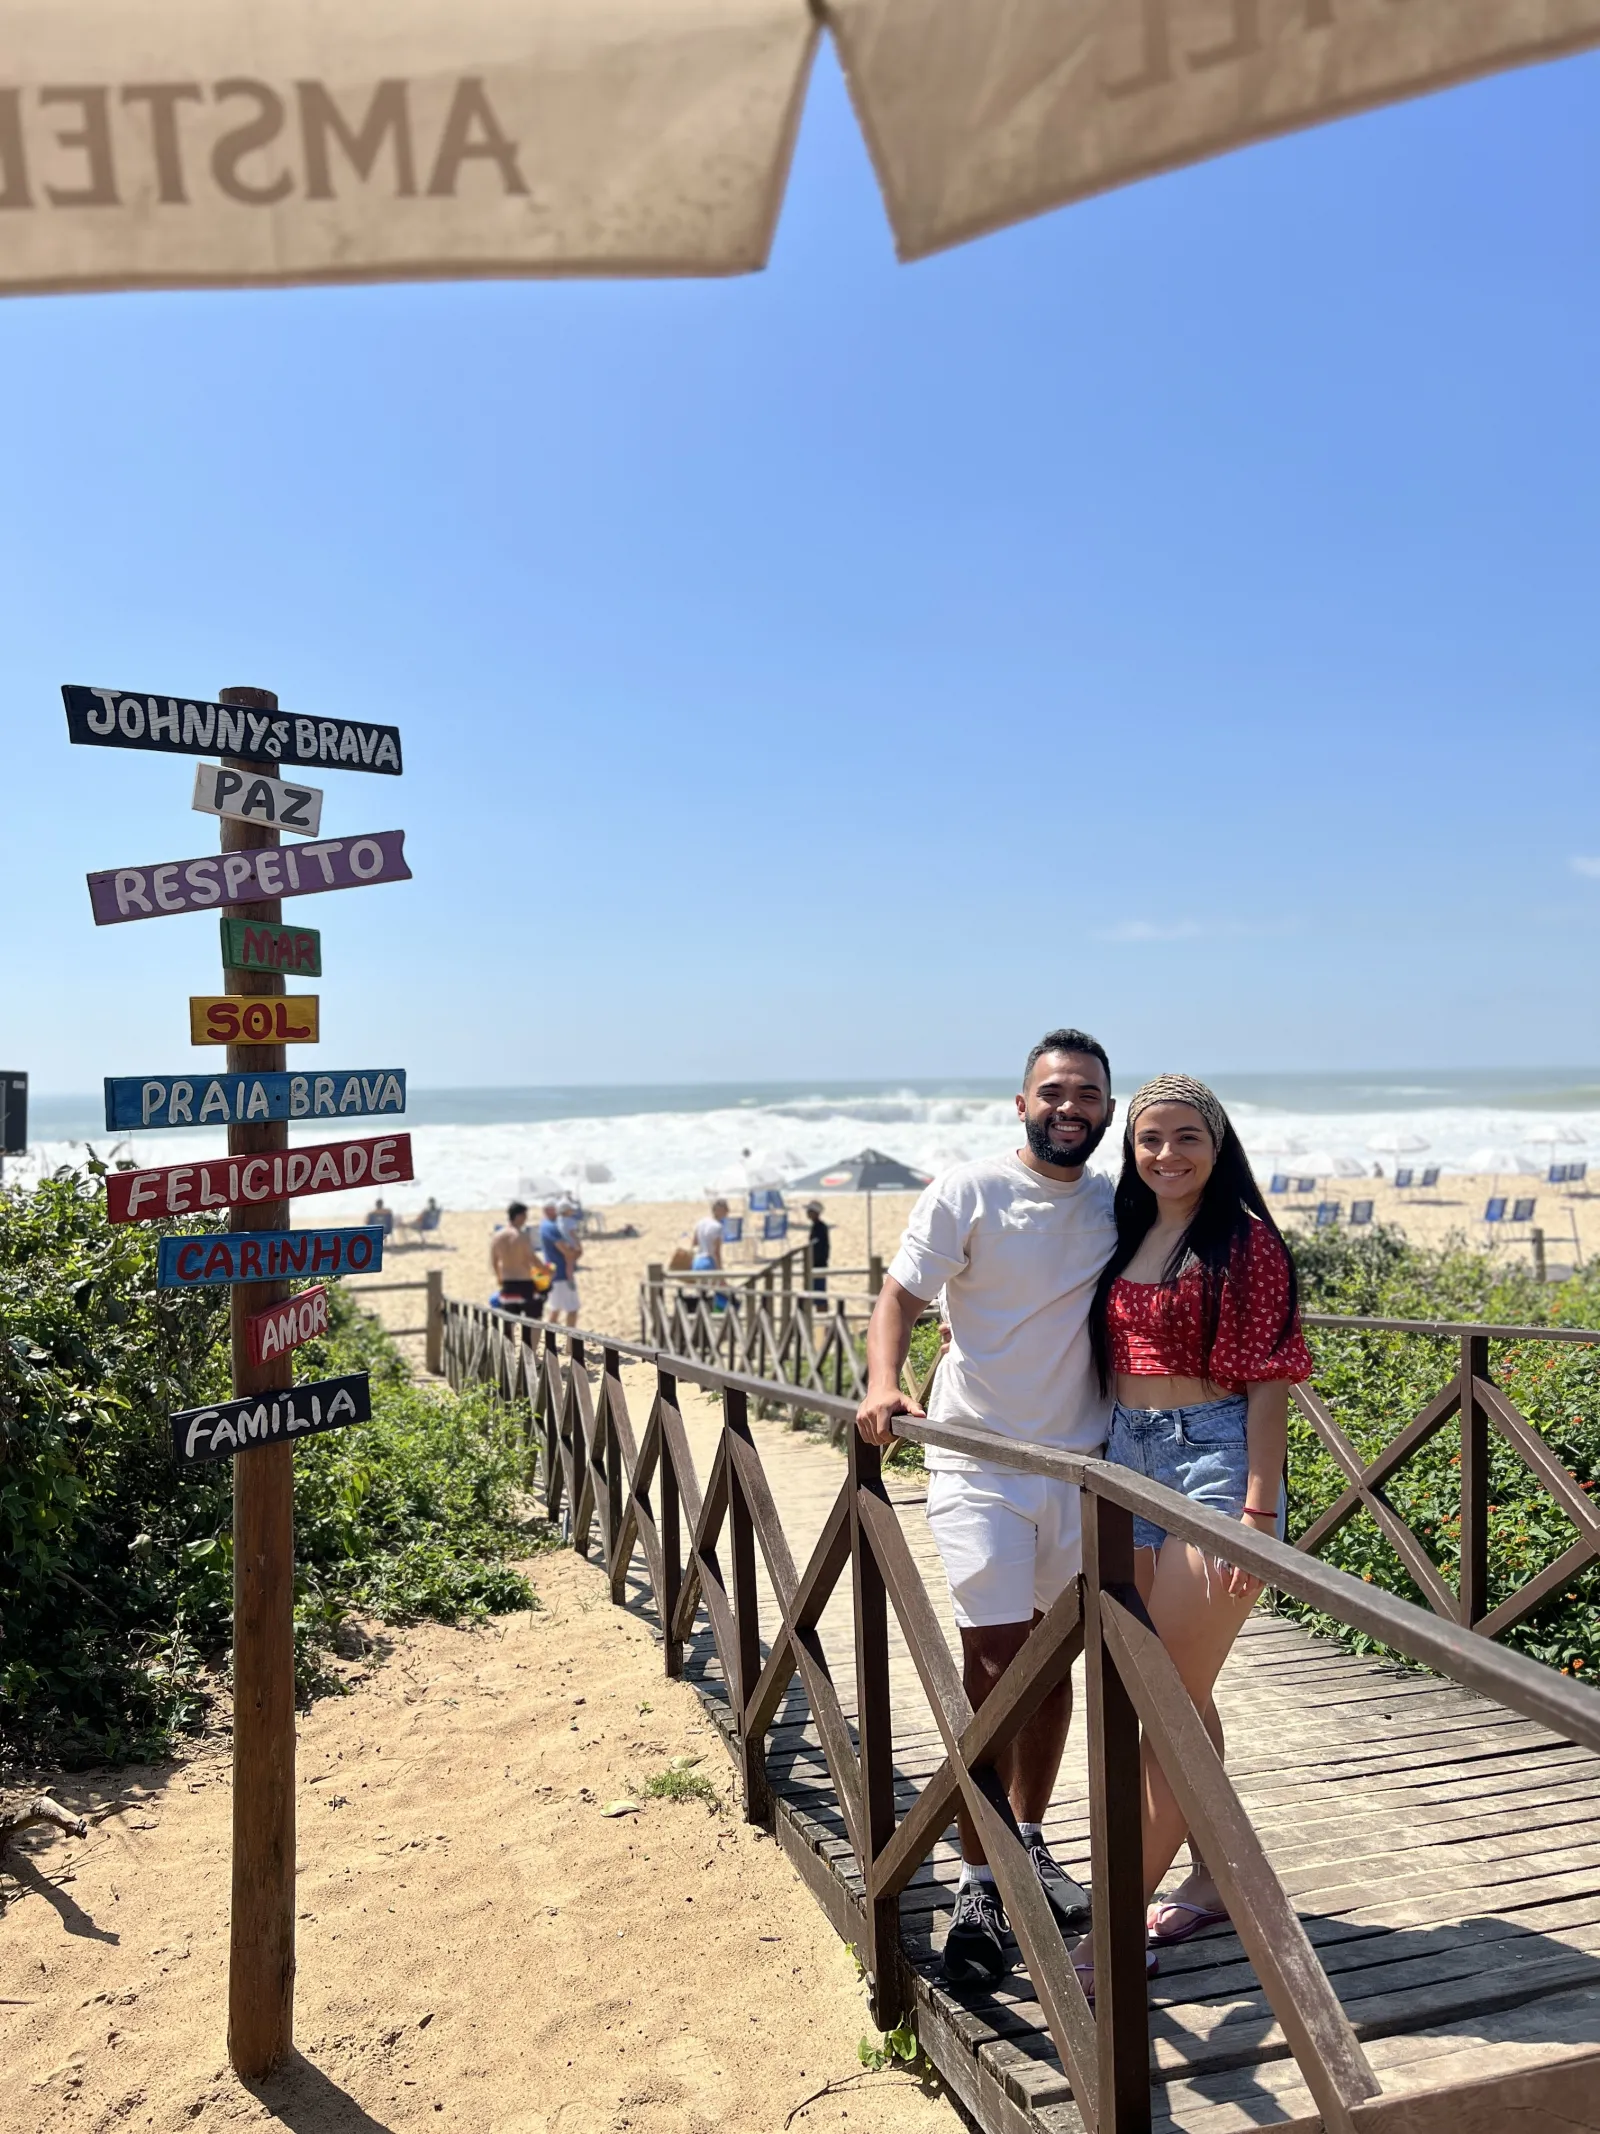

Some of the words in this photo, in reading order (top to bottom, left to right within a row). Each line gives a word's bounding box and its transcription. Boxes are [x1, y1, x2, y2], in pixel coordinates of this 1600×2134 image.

[86, 687, 269, 752] JOHNNY
[294, 718, 400, 770] BRAVA
[214, 770, 312, 827] PAZ
[114, 839, 385, 915] RESPEITO
[242, 926, 318, 970] MAR
[206, 1002, 311, 1041] SOL
[142, 1081, 271, 1126] PRAIA
[290, 1073, 403, 1118] BRAVA
[127, 1139, 401, 1217] FELICIDADE
[176, 1234, 374, 1281] CARINHO
[261, 1294, 328, 1361] AMOR
[185, 1388, 357, 1459] FAMÍLIA
